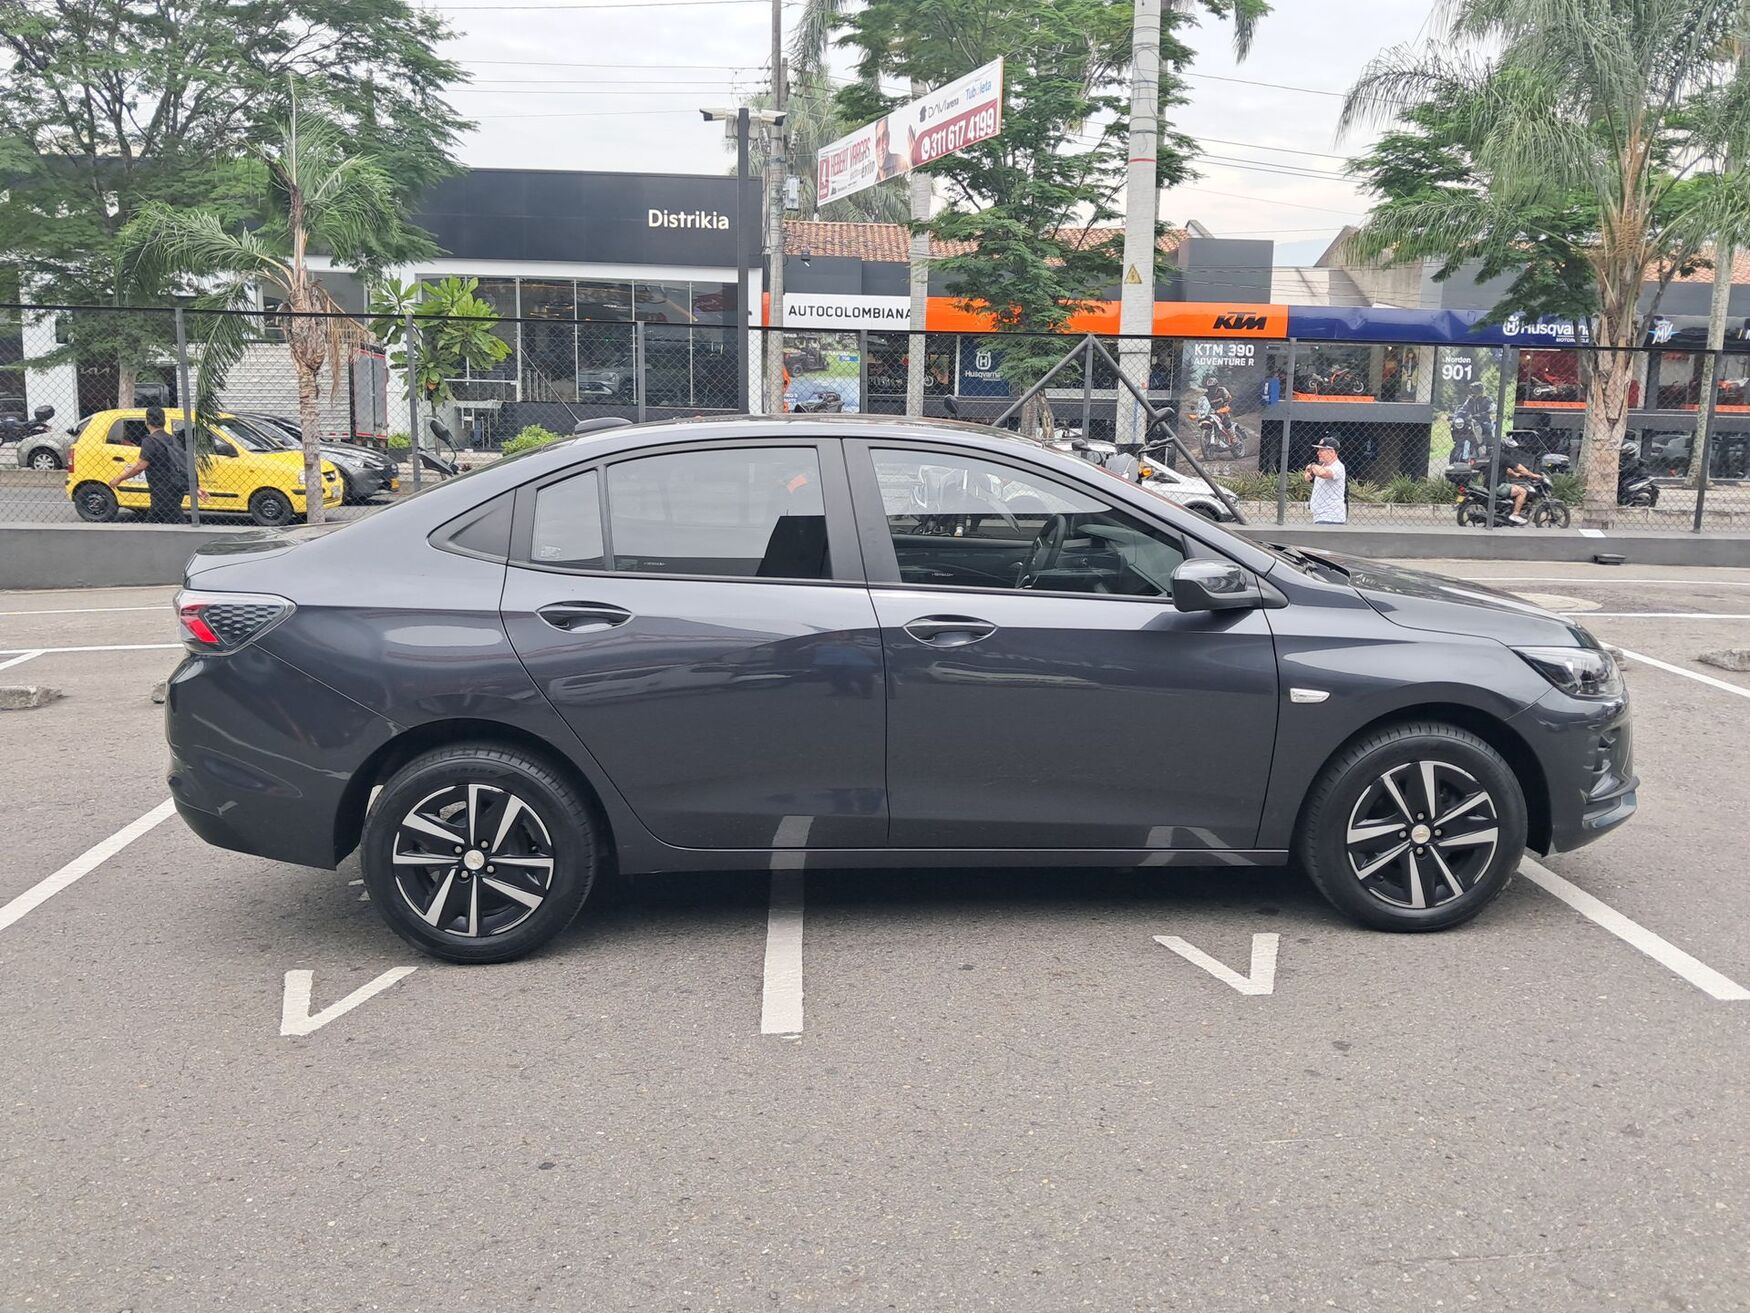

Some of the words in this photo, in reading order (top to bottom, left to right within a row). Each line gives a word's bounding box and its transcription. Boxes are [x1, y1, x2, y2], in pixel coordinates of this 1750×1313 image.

[930, 128, 947, 157] 311
[947, 119, 966, 150] 617
[966, 107, 995, 141] 4199
[648, 209, 730, 230] Distrikia
[788, 304, 911, 319] AUTOCOLOMBIANA
[1212, 312, 1267, 330] KTM
[1194, 344, 1223, 356] KTM
[1228, 345, 1254, 357] 390
[1194, 357, 1246, 366] ADVENTURE
[1248, 358, 1254, 366] R
[1445, 356, 1472, 364] Norden
[1442, 364, 1472, 381] 901
